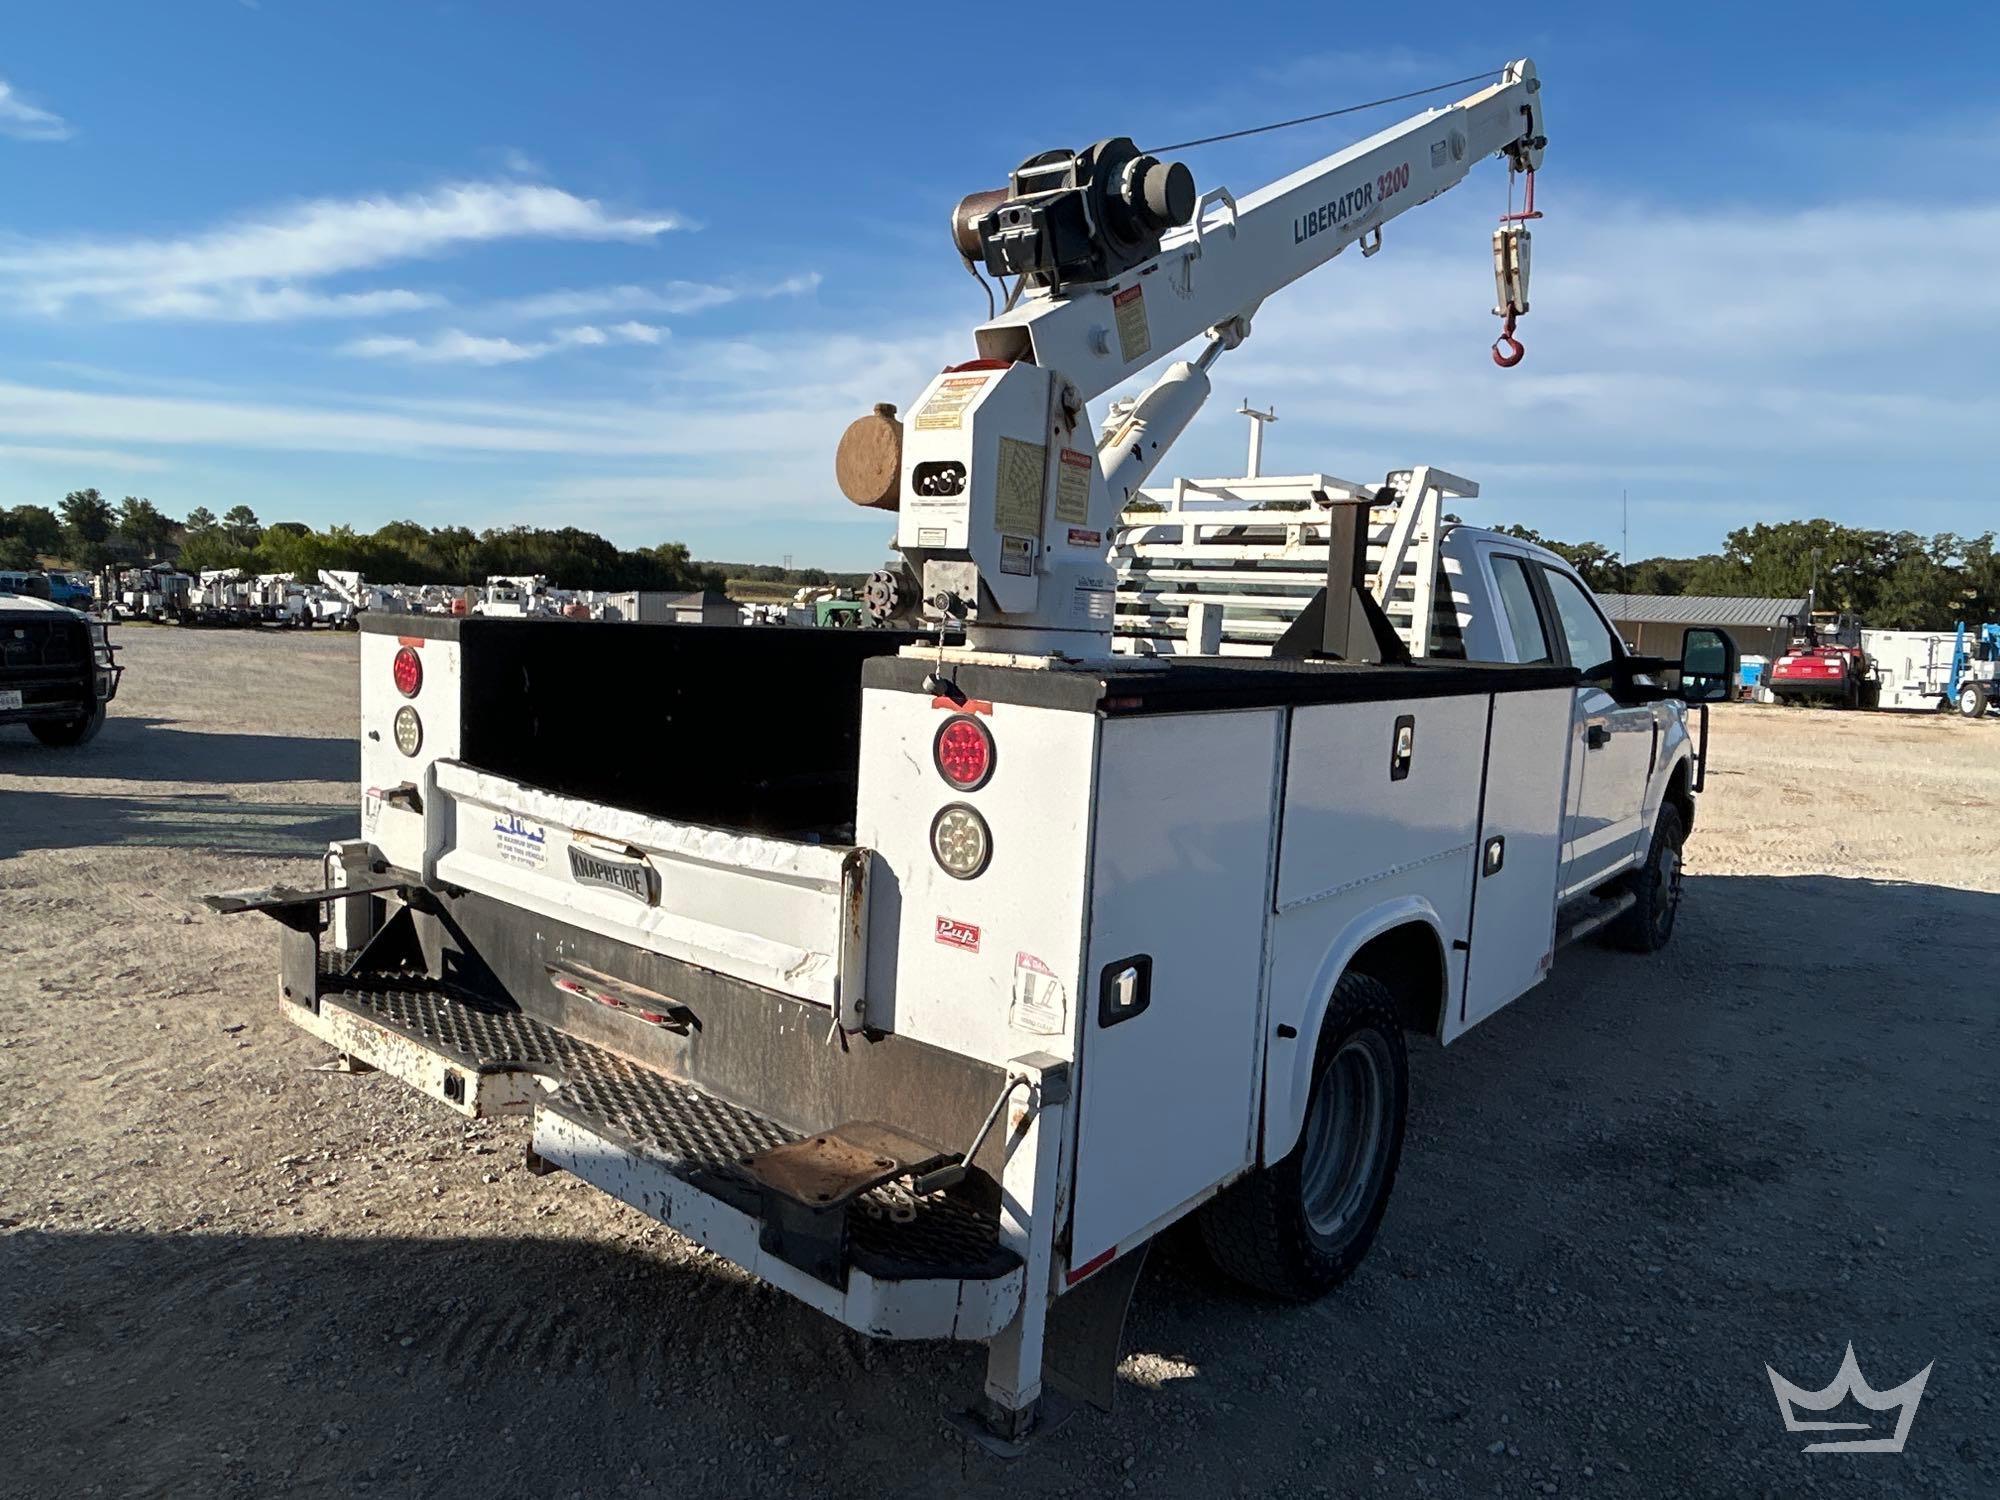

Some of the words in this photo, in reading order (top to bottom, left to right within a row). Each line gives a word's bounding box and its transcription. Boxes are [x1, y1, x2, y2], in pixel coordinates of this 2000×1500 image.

[1294, 182, 1373, 245] LIBERATOR
[1376, 162, 1410, 202] 3200
[571, 850, 644, 896] KNAPHEIDE
[938, 919, 976, 944] Pup
